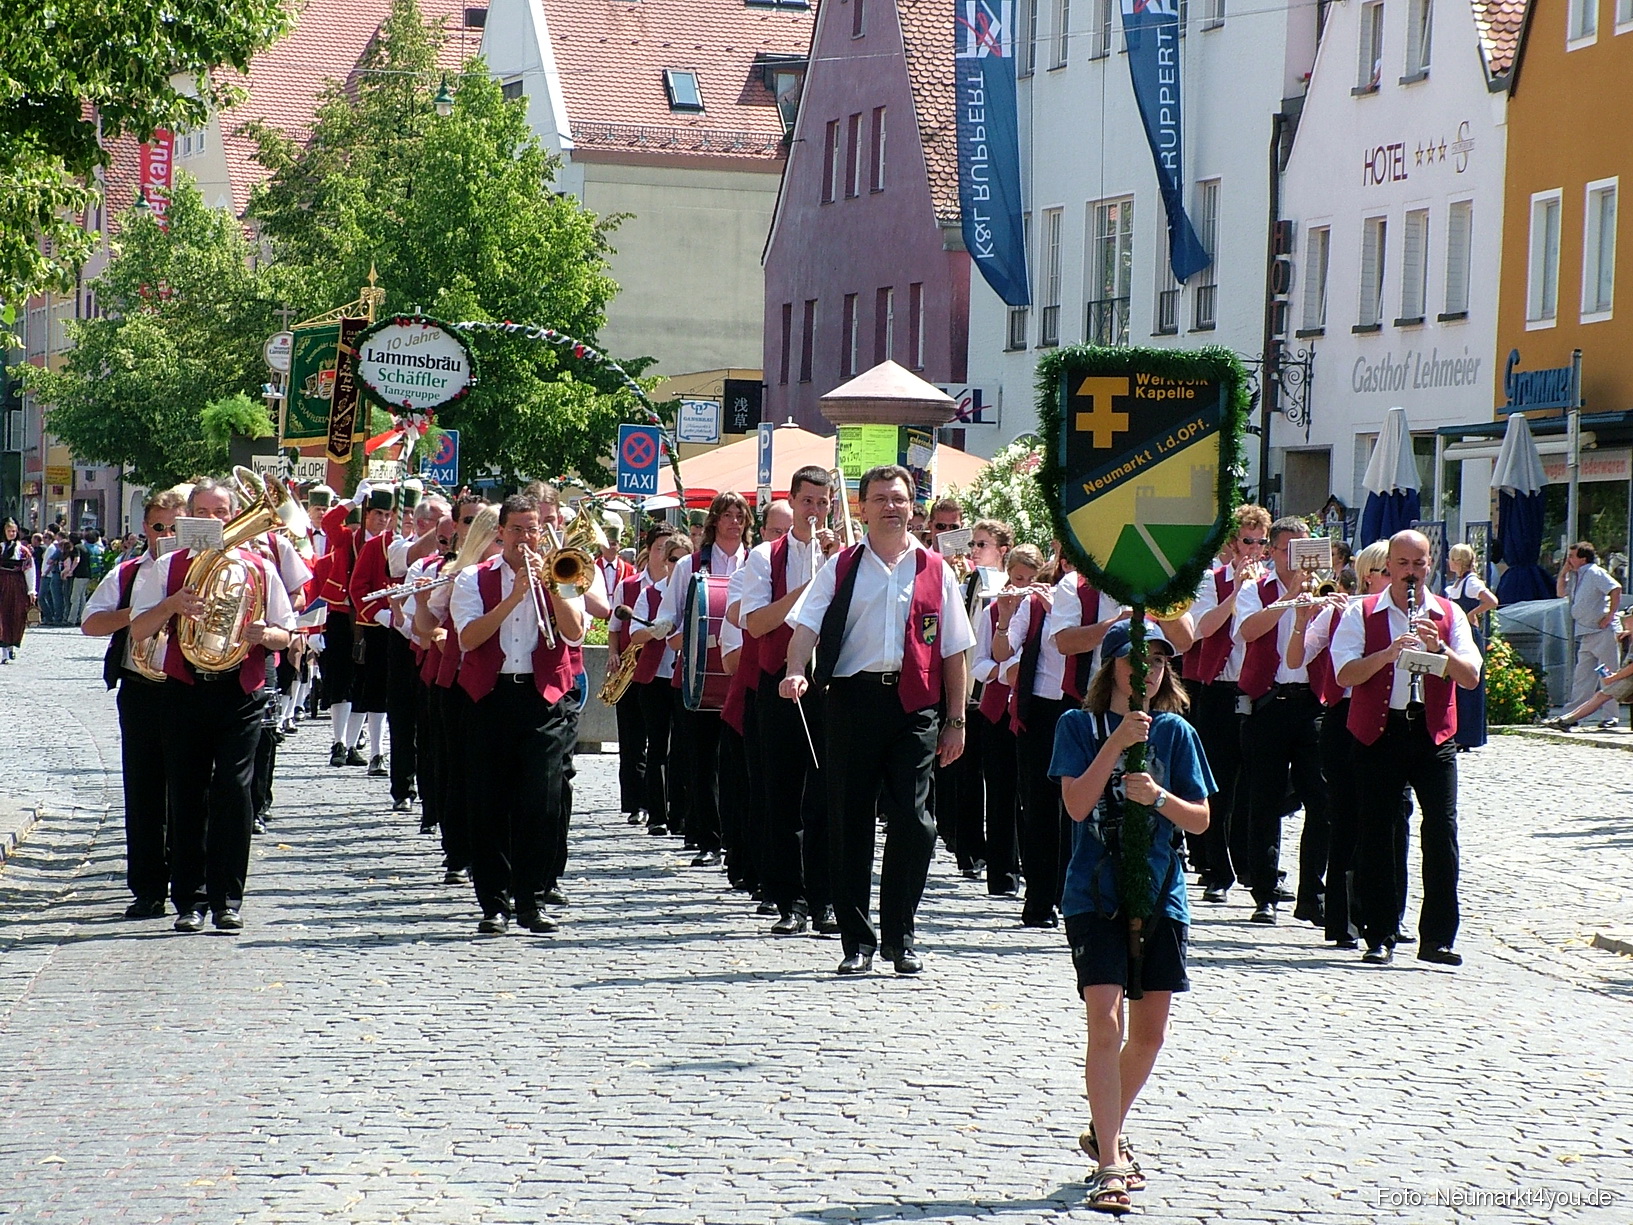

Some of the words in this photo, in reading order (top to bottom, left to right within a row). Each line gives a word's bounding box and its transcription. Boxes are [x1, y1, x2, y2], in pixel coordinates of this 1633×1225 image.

[1157, 26, 1178, 169] RUPPERT
[1363, 142, 1408, 186] HOTEL
[386, 337, 401, 351] 10
[405, 330, 440, 347] Jahre
[366, 348, 461, 372] Lammsbräu
[1352, 350, 1412, 393] Gasthof
[1412, 345, 1481, 389] Lehmeier
[377, 367, 448, 389] Schäffler
[383, 385, 441, 402] Tanzgruppe
[1135, 386, 1195, 401] Kapelle
[760, 429, 770, 464] P
[253, 461, 293, 476] Neumr
[1083, 449, 1153, 495] Neumarkt
[621, 473, 654, 489] TAXI
